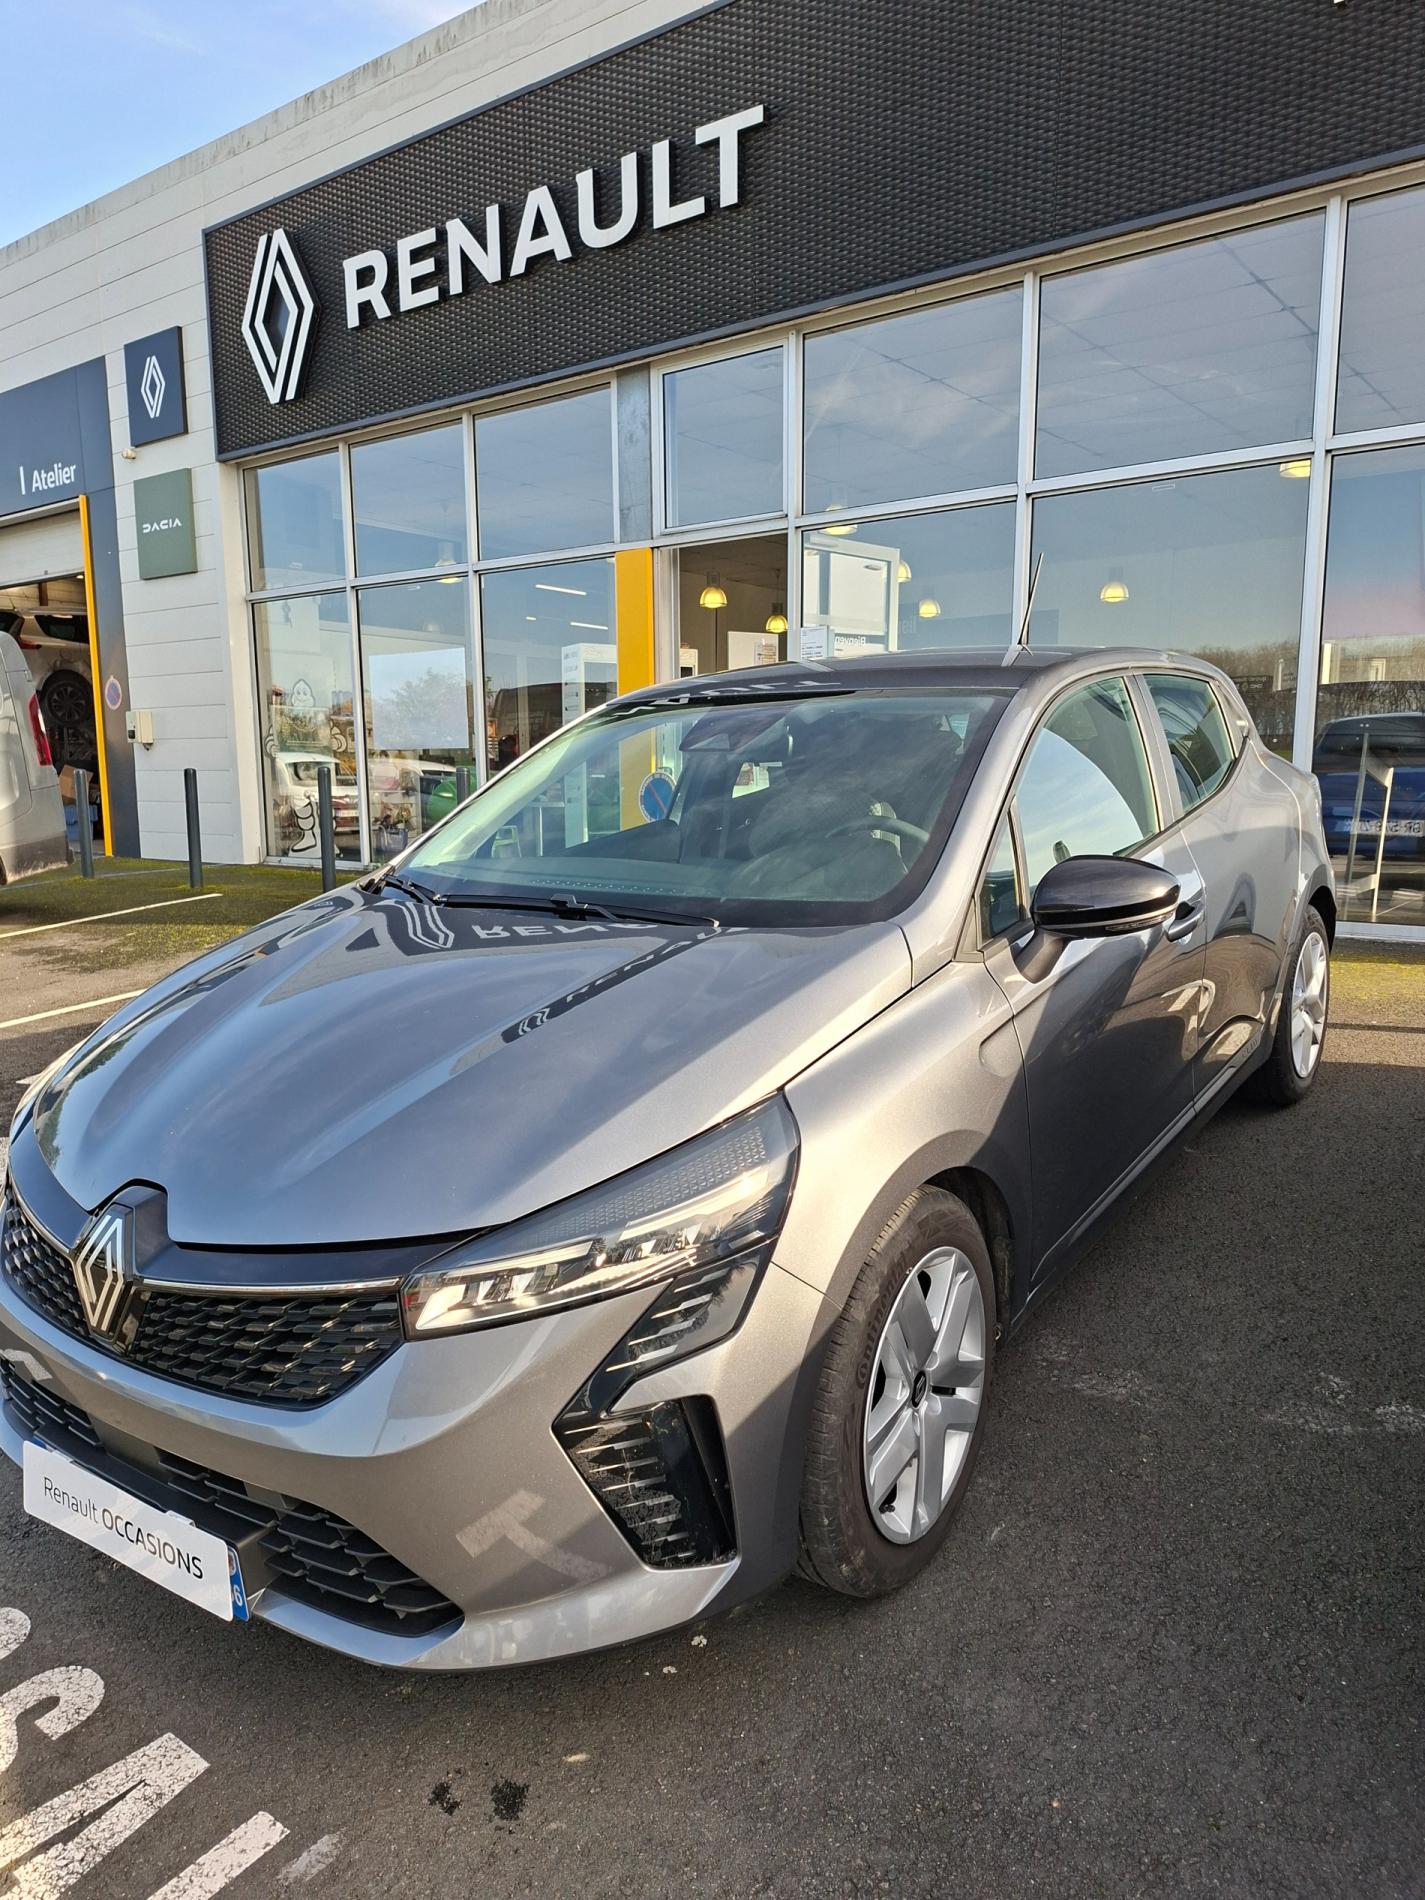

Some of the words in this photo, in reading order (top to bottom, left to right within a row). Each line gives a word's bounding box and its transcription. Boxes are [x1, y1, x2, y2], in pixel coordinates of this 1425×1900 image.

[343, 104, 764, 329] RENAULT
[32, 462, 76, 493] Atelier
[142, 517, 182, 534] DACIA
[43, 1476, 98, 1524] Renault
[102, 1508, 204, 1580] OCCASIONS
